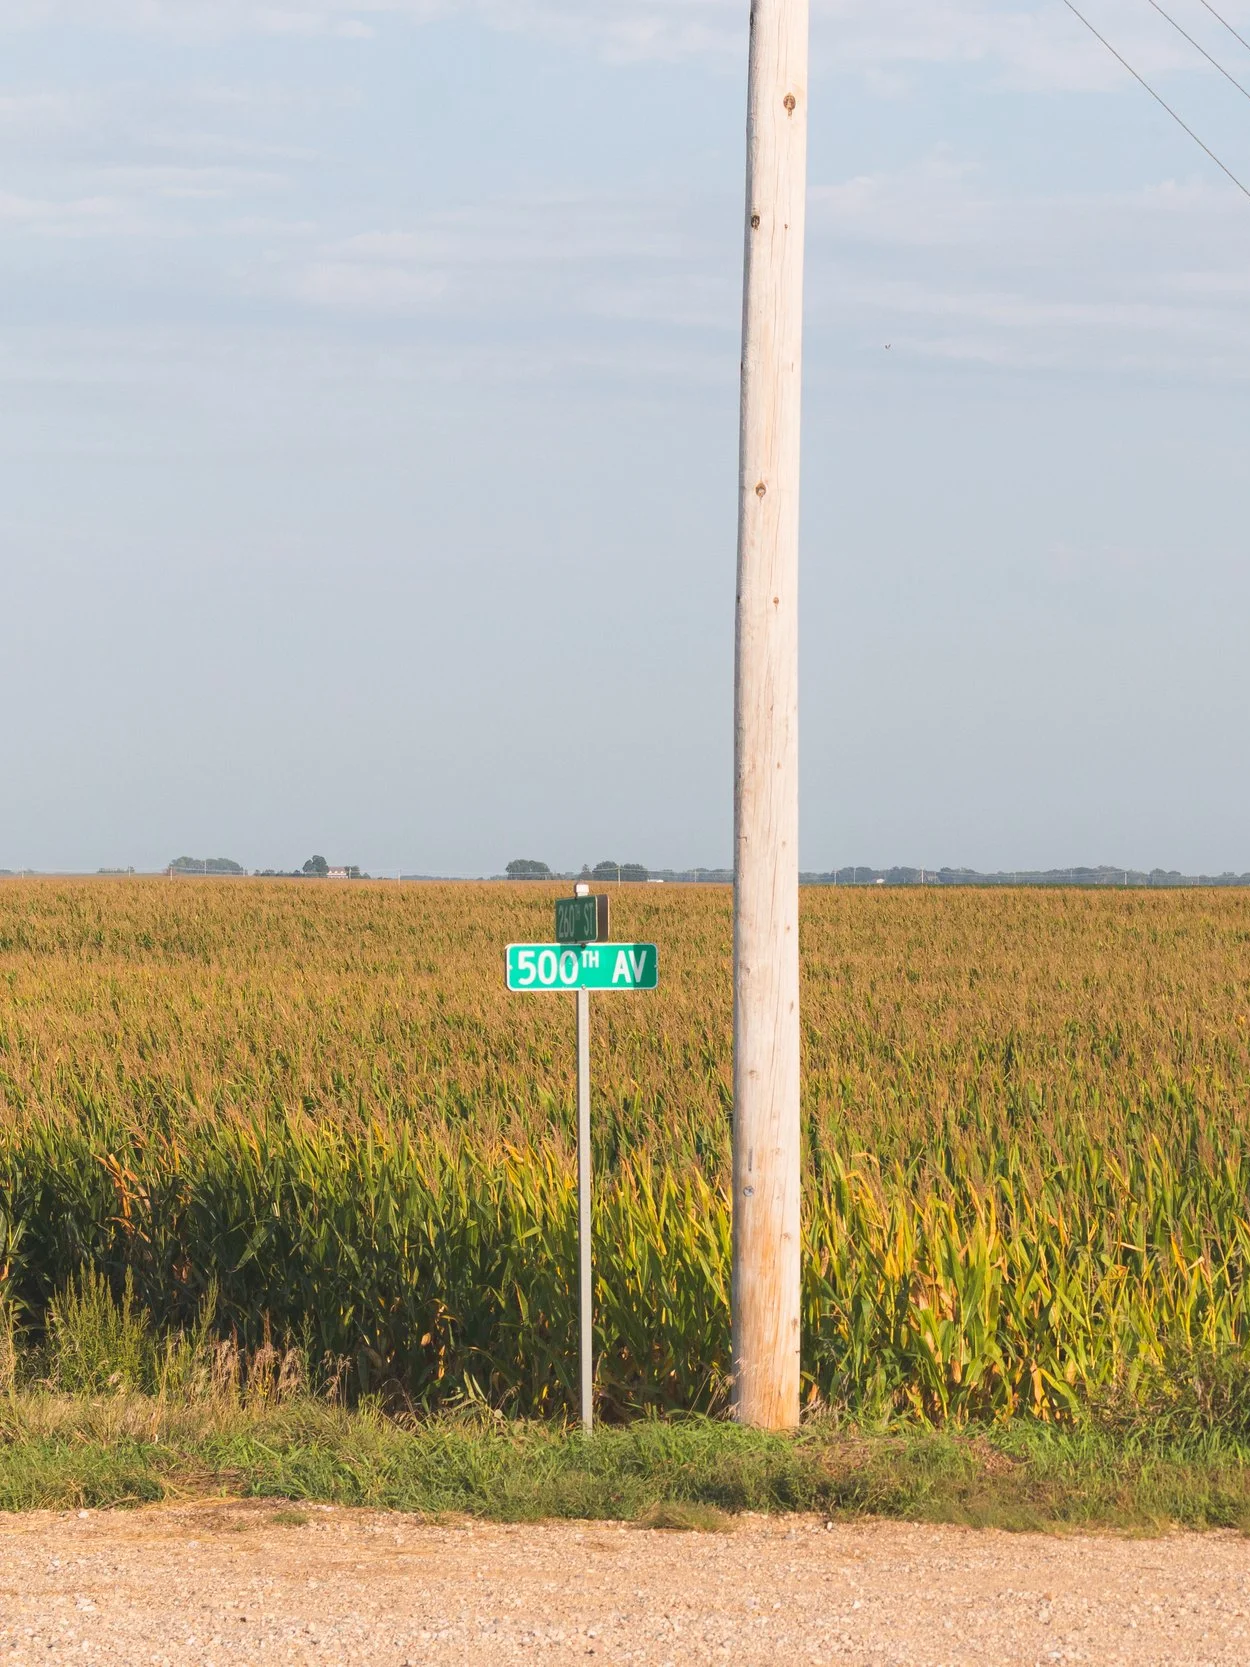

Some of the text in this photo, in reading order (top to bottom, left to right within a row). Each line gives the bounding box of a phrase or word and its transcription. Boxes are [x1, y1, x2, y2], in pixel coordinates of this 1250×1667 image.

[583, 903, 594, 936] ST
[517, 950, 647, 985] 500TH AV
